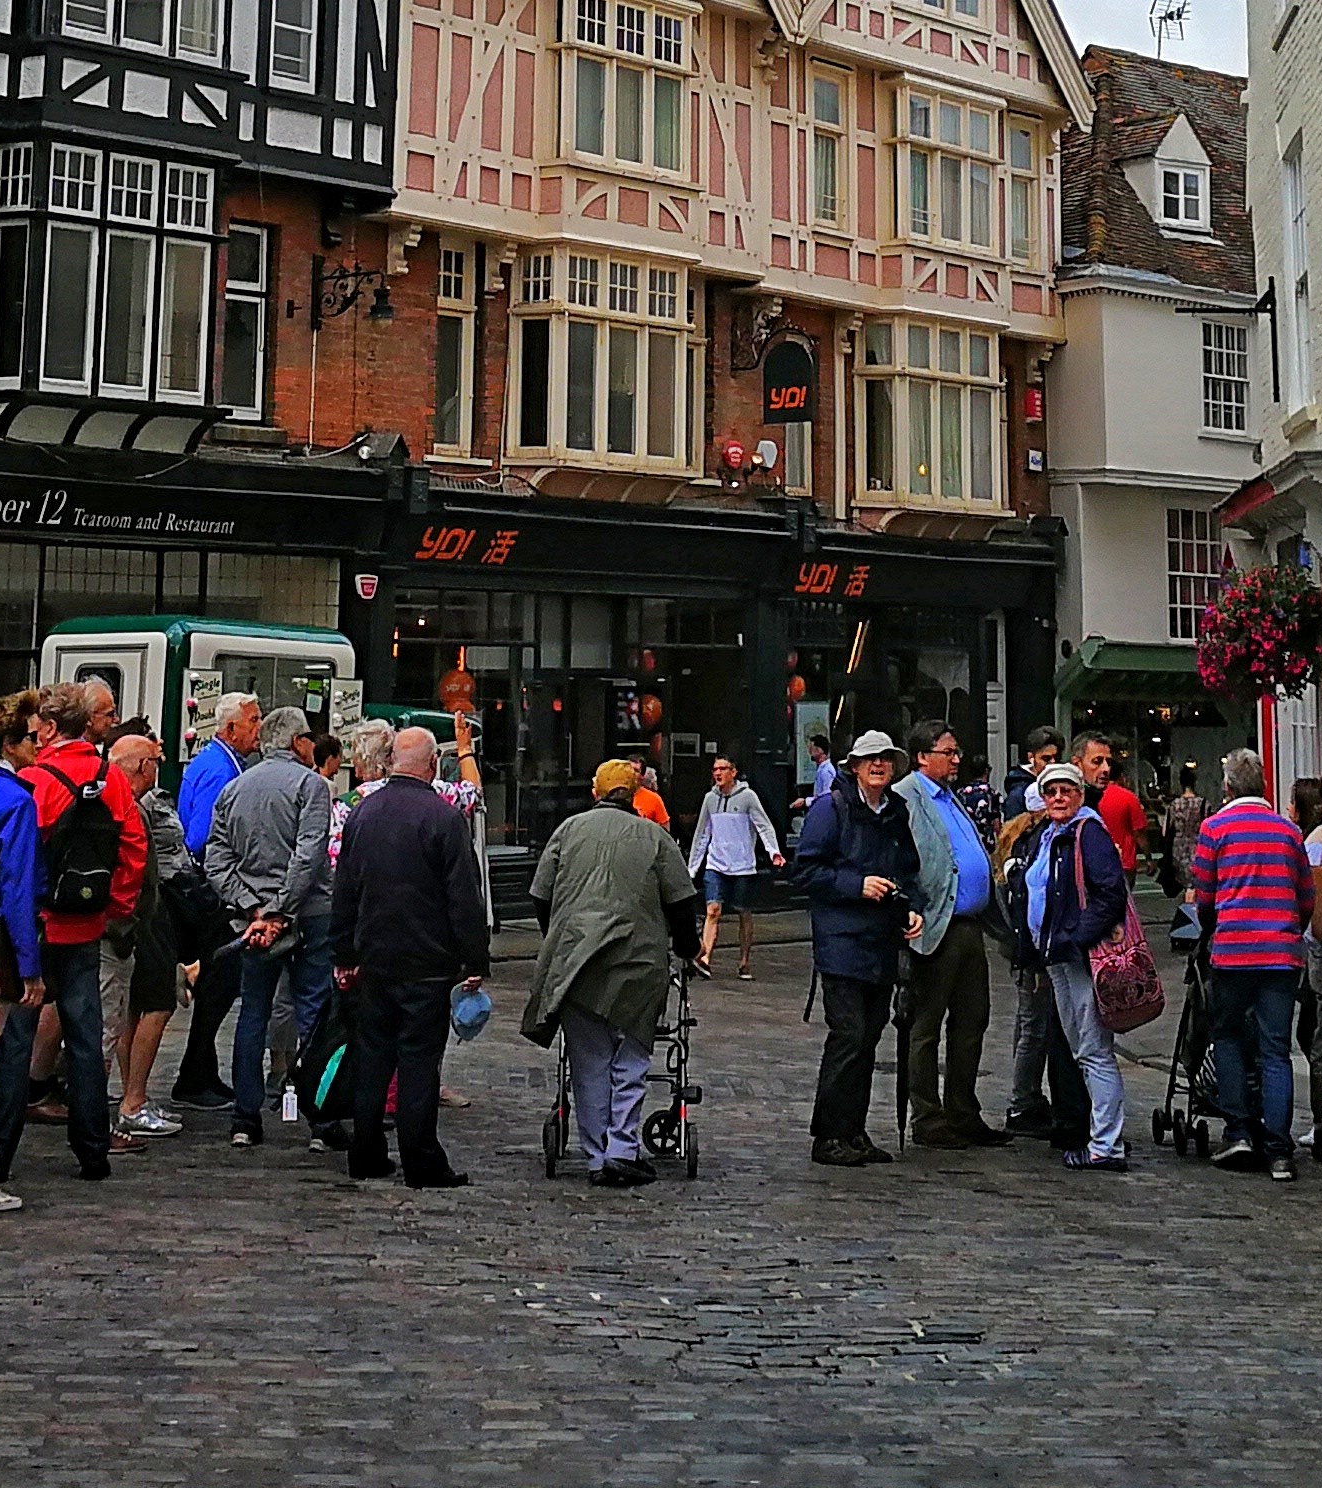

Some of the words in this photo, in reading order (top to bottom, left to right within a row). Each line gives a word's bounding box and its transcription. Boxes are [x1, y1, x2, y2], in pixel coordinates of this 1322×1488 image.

[769, 386, 806, 409] YO!
[35, 489, 68, 525] 12
[73, 508, 132, 529] Tearoom
[136, 512, 160, 530] and
[165, 513, 234, 534] Restaurant
[415, 526, 476, 560] YO!
[481, 530, 519, 564] 活
[794, 562, 839, 594] YO!
[843, 565, 871, 597] 活
[196, 678, 221, 692] Single
